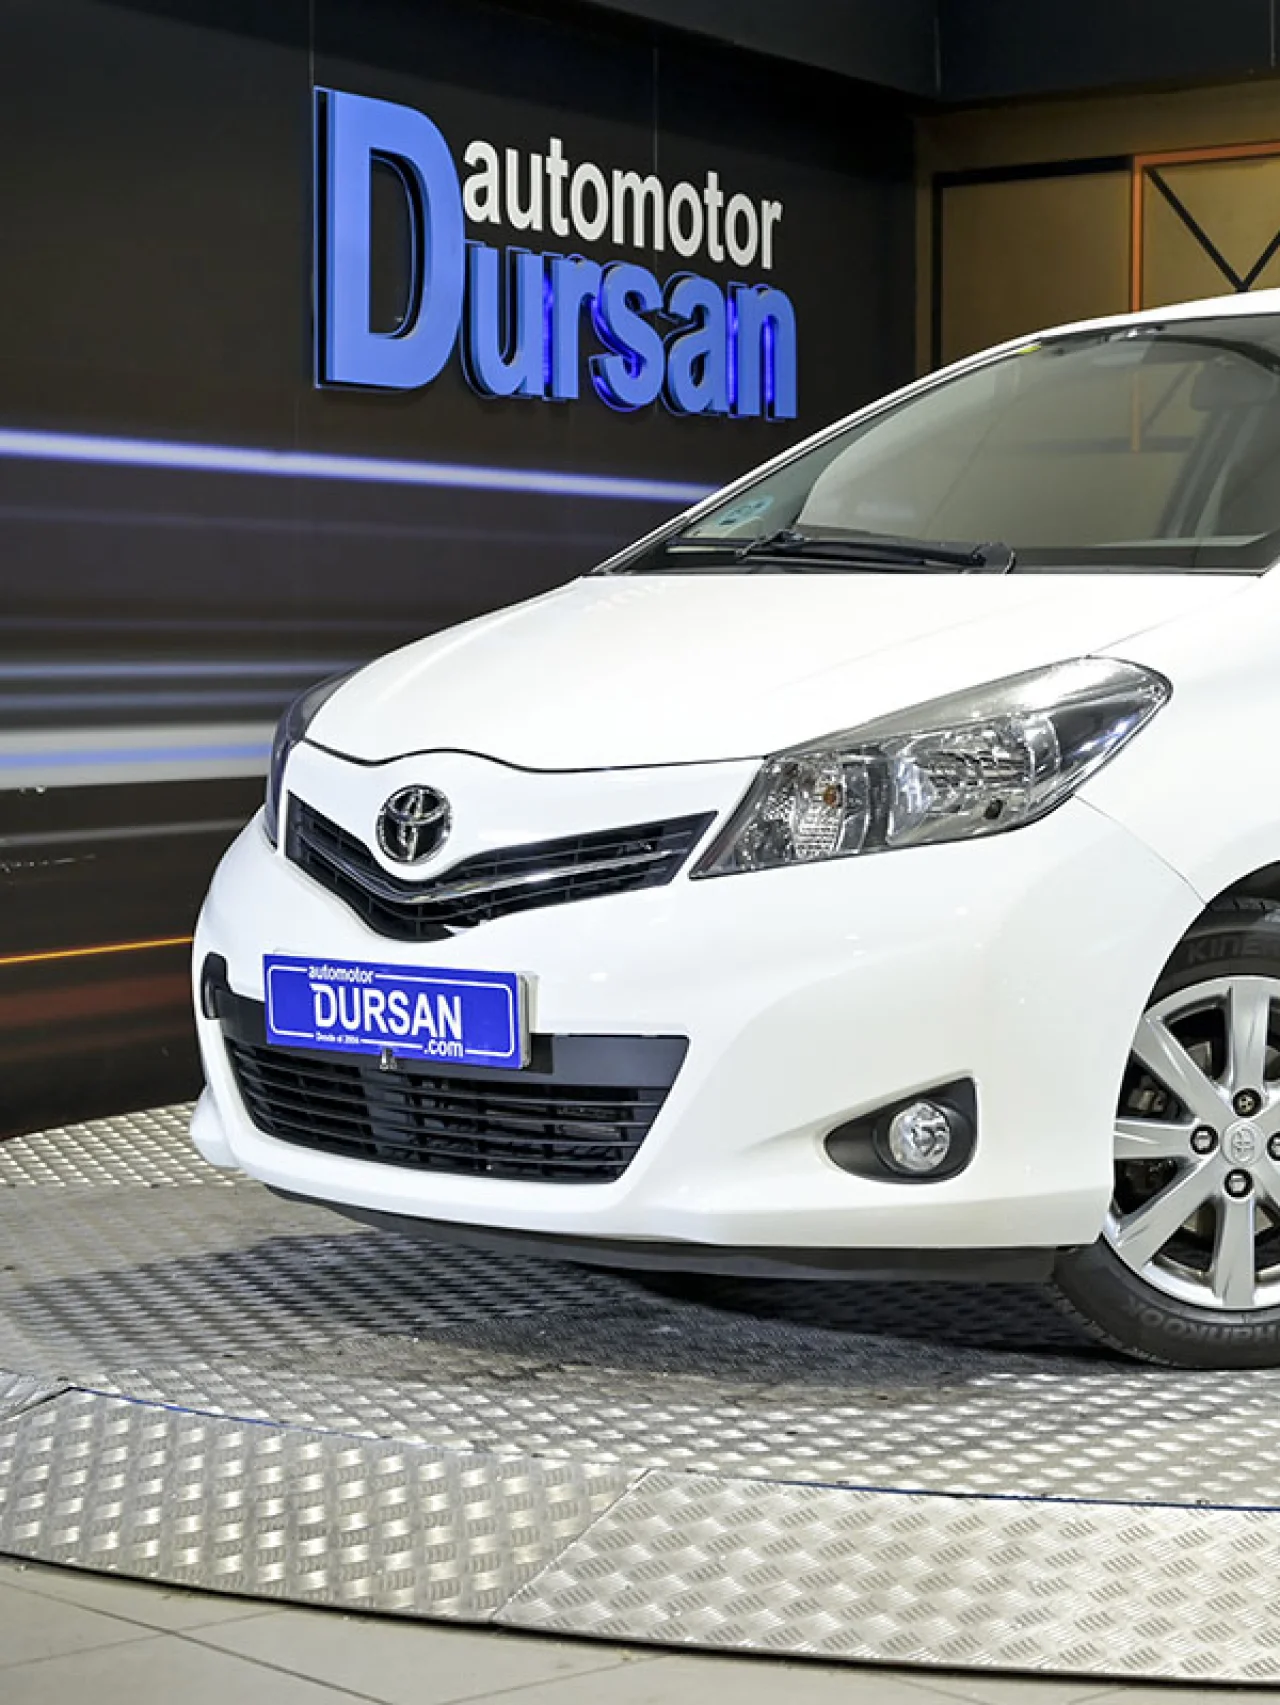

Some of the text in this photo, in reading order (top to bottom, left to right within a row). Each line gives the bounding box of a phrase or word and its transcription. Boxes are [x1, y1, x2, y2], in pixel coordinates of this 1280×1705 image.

[462, 137, 783, 269] automotor
[313, 85, 797, 422] Dursan
[308, 964, 374, 984] automotor
[310, 983, 462, 1040] DURSAN
[424, 1038, 463, 1057] .com
